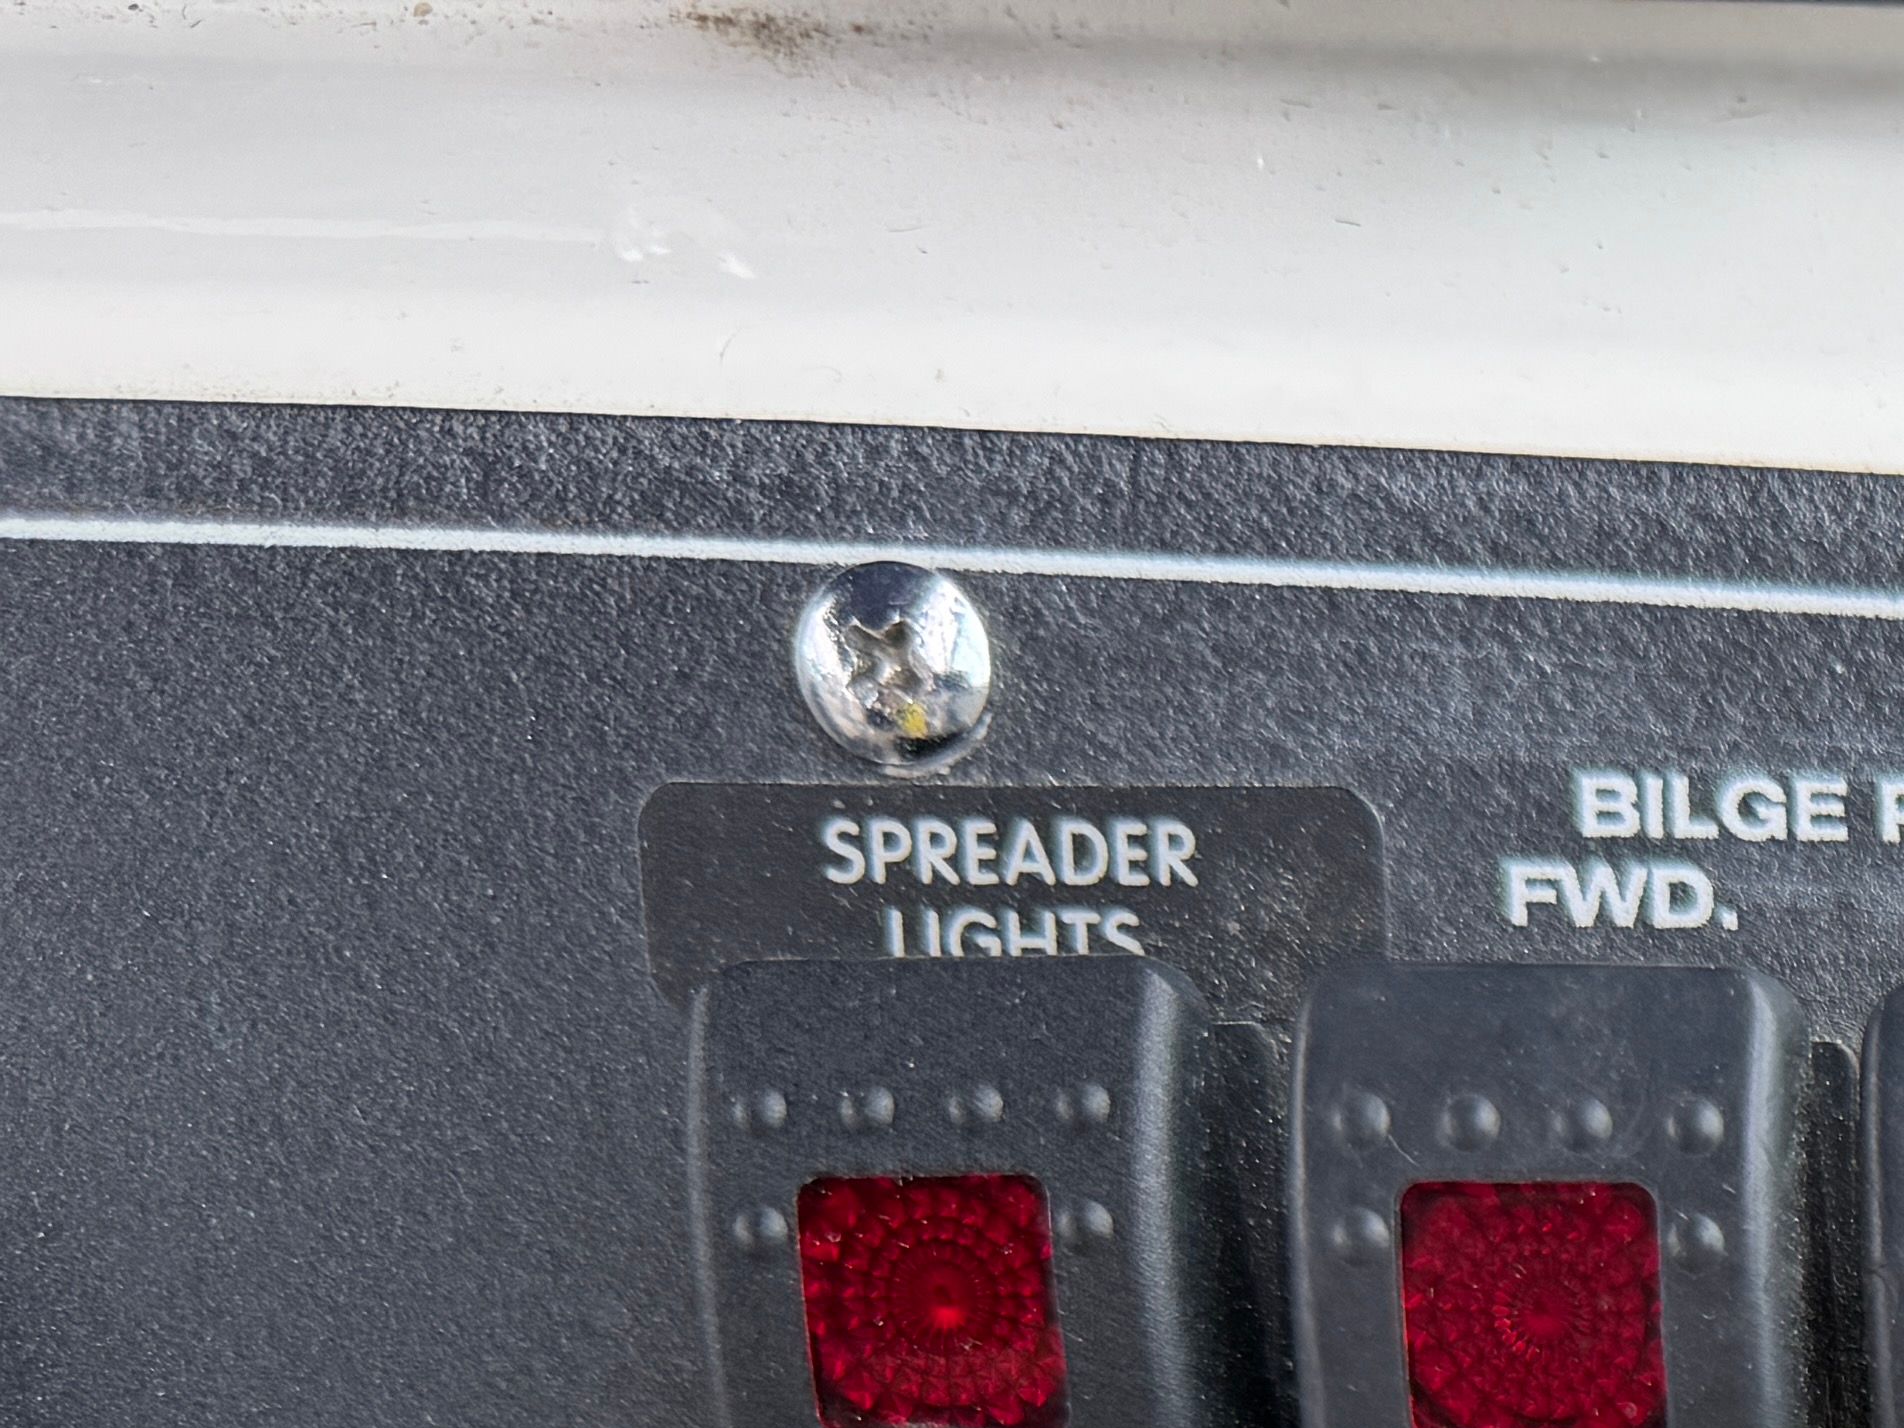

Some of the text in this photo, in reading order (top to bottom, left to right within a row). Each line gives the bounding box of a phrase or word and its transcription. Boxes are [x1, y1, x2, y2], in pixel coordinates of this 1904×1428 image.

[1576, 771, 1849, 847] BILGE
[825, 818, 1199, 886] SPREADER
[1507, 858, 1739, 933] FWD.
